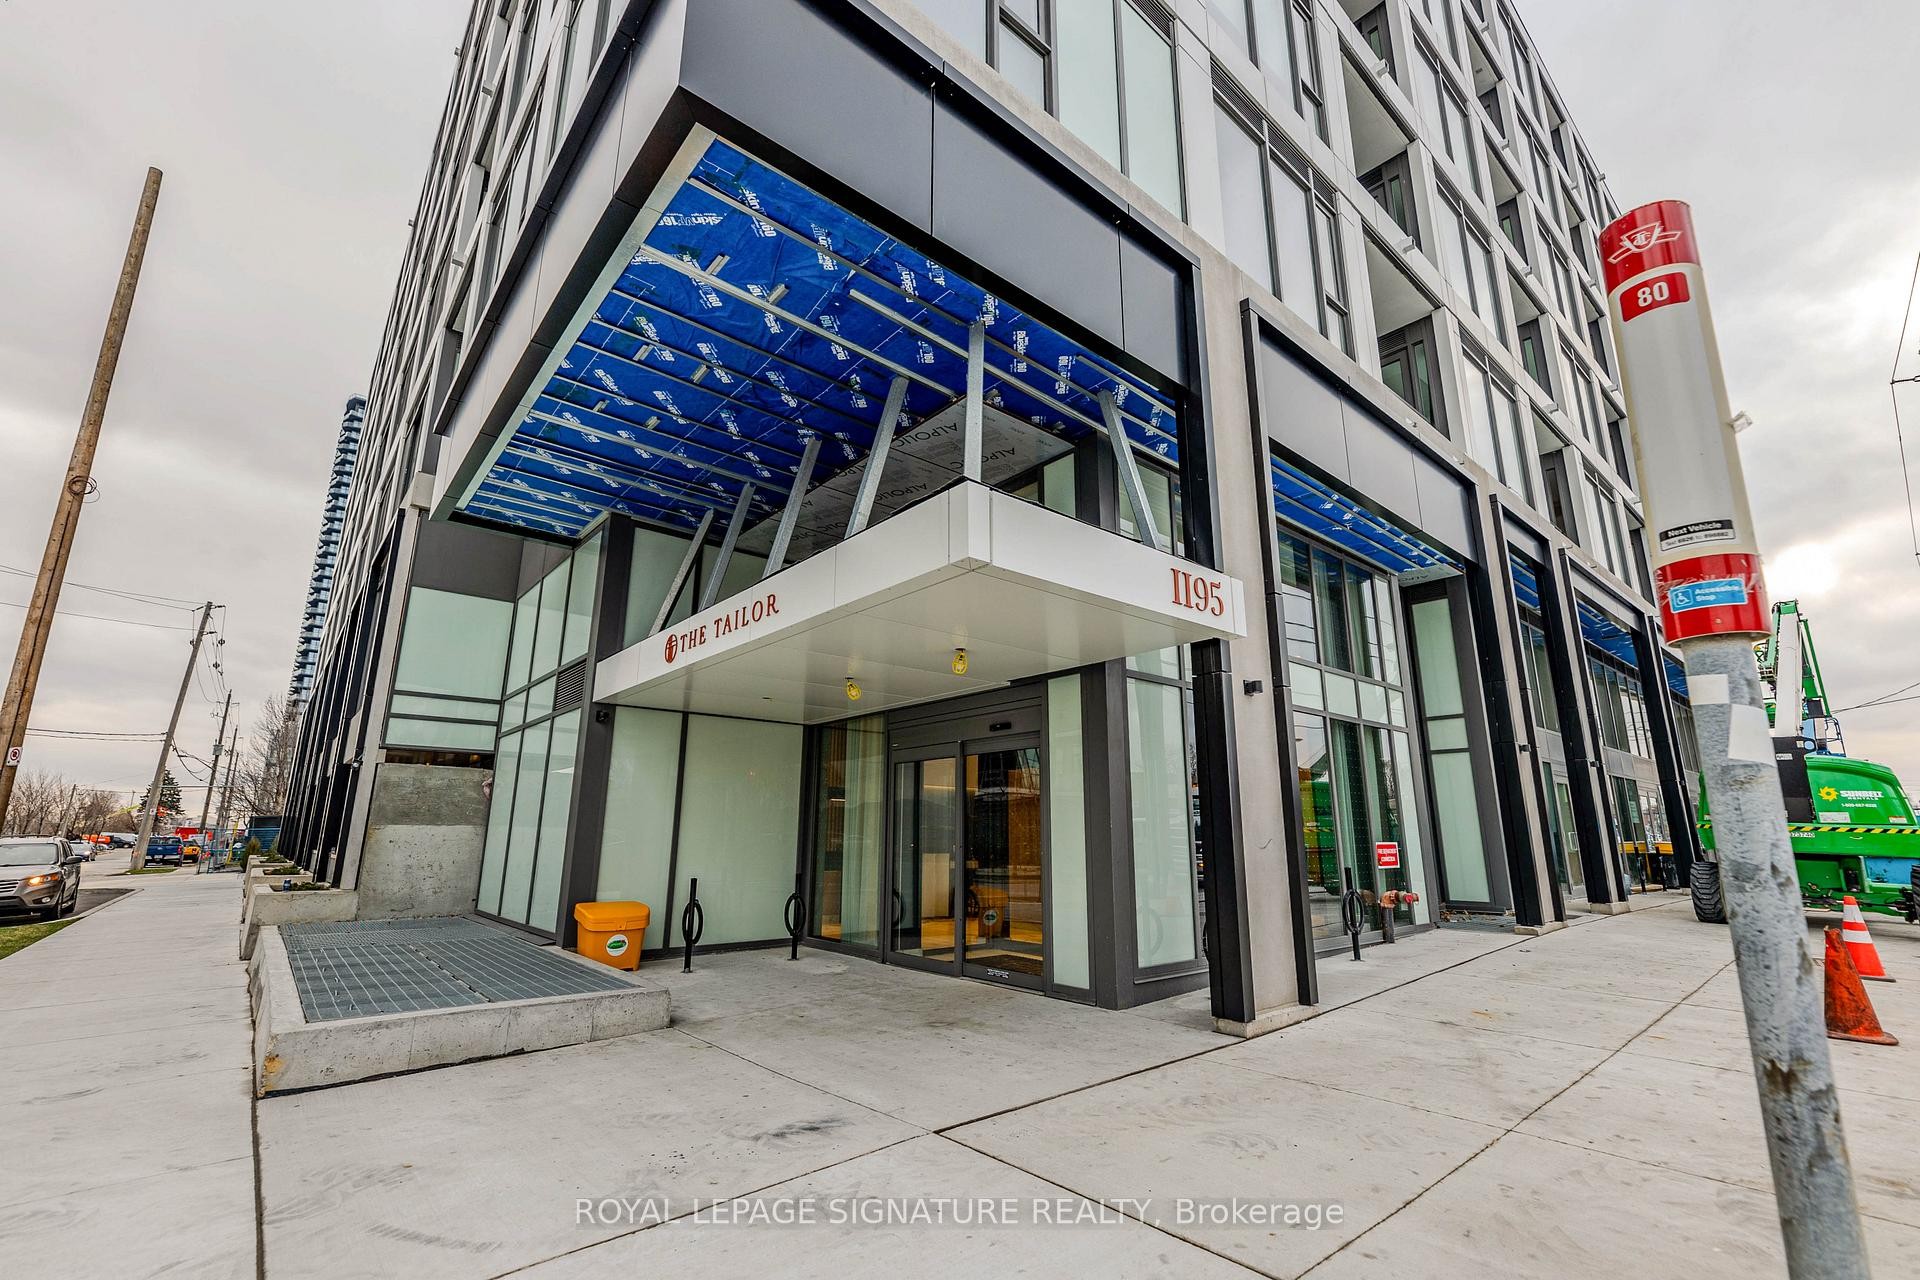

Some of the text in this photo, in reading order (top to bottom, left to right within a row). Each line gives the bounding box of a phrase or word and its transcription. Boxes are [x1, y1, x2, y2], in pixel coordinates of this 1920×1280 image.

[1637, 282, 1669, 307] 80
[1667, 521, 1722, 538] Next Vehicle
[1170, 568, 1225, 617] 1195
[680, 594, 779, 653] THE TAILOR
